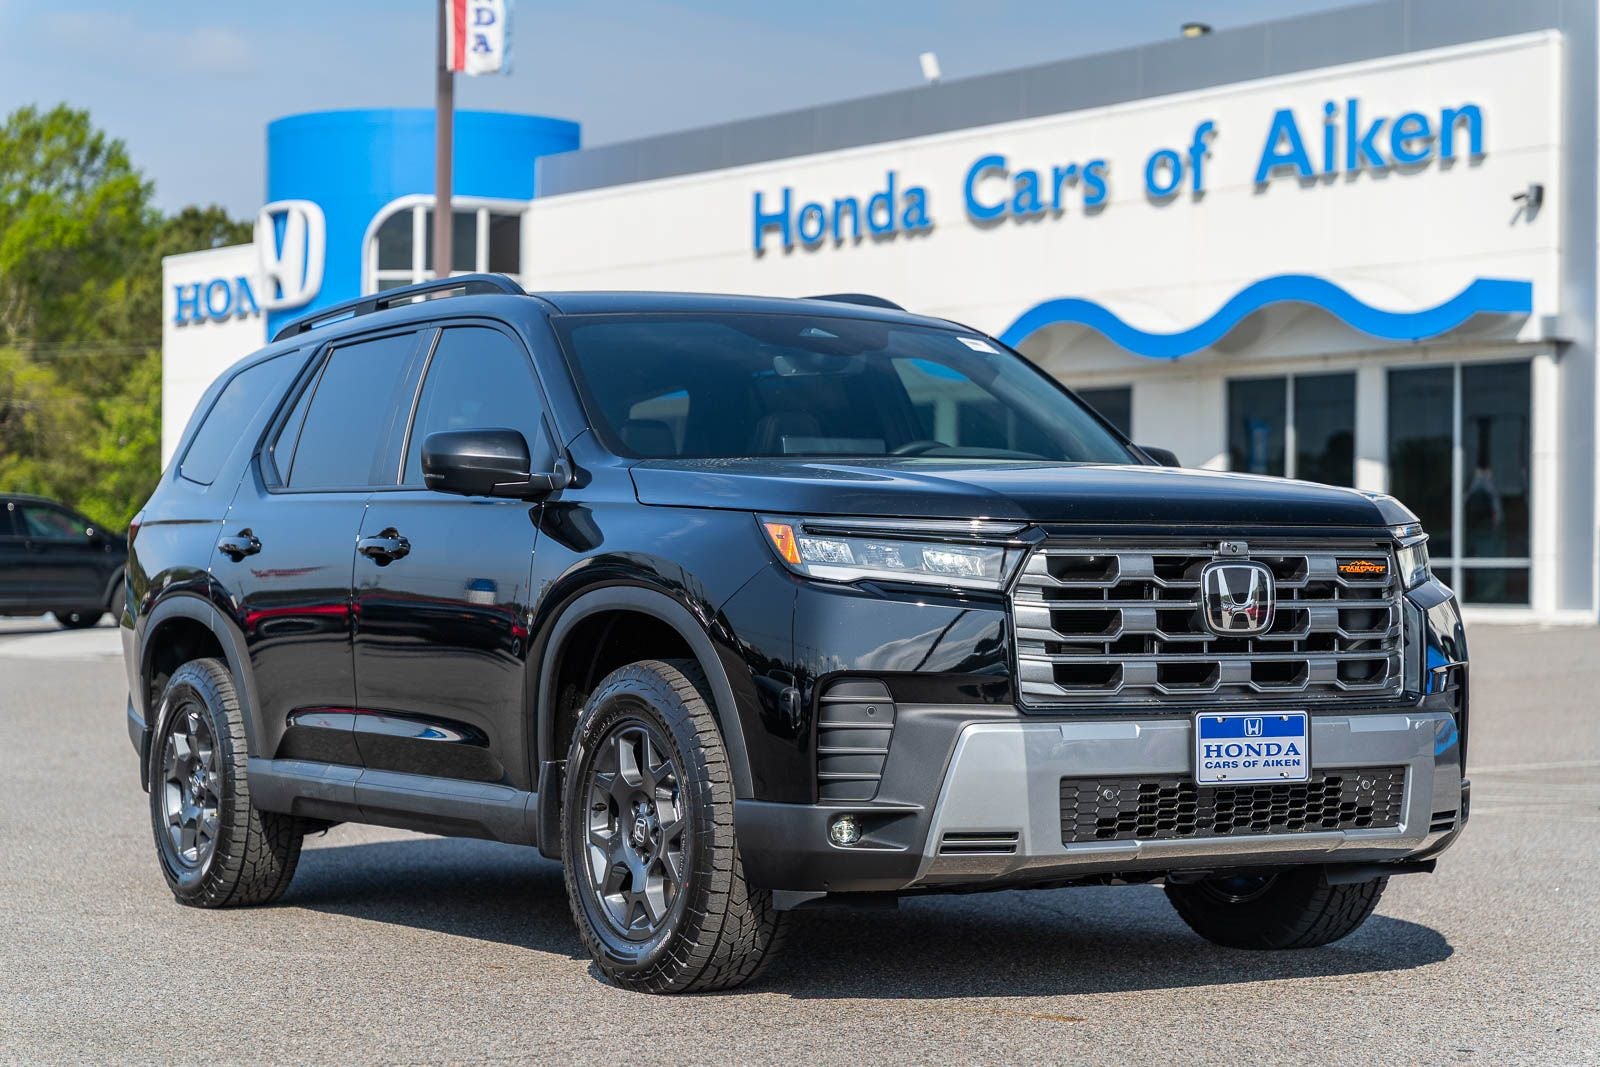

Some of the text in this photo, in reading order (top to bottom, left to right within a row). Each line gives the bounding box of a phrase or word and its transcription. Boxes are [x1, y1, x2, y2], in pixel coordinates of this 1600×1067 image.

[472, 0, 496, 52] DA
[753, 97, 1484, 250] Honda Cars of Aiken
[1338, 565, 1386, 573] TRAILSPORT
[1204, 742, 1301, 758] HONDA
[1204, 758, 1301, 769] CARS OF AIKEN
